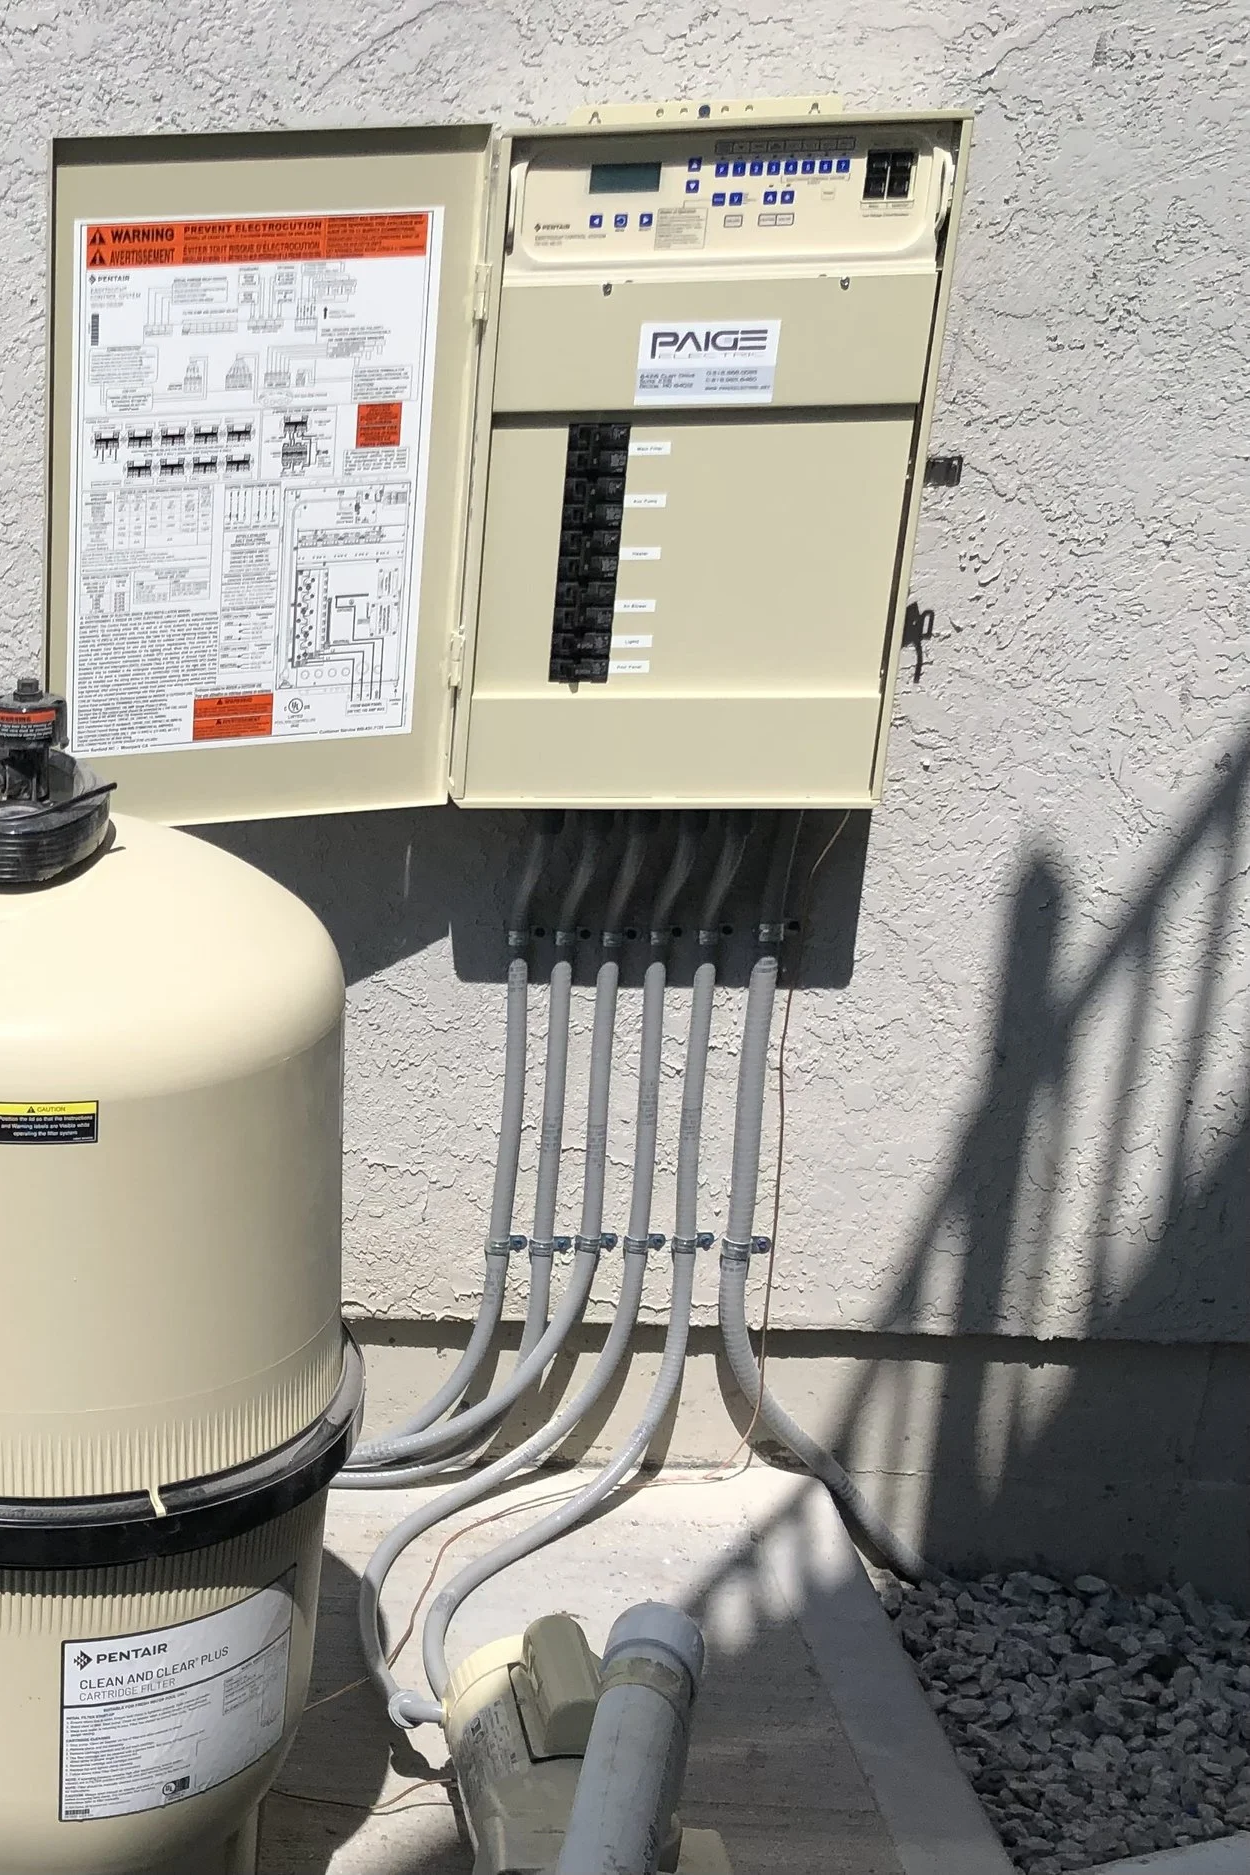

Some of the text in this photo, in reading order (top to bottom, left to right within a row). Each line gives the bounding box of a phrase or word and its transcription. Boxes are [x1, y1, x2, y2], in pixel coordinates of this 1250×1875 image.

[110, 227, 174, 244] WARNING
[184, 224, 232, 235] PREVENT
[235, 221, 322, 233] ELECTROCUTION
[109, 247, 175, 266] AVERTISSEMENT
[97, 275, 130, 283] PENTAIR
[650, 329, 768, 359] PAIGE
[96, 1642, 168, 1665] PENTAIR
[79, 1675, 125, 1690] CLEAN
[127, 1670, 154, 1686] AND
[200, 1646, 229, 1666] PLUS
[79, 1677, 176, 1702] CARTRIDGE FILTER
